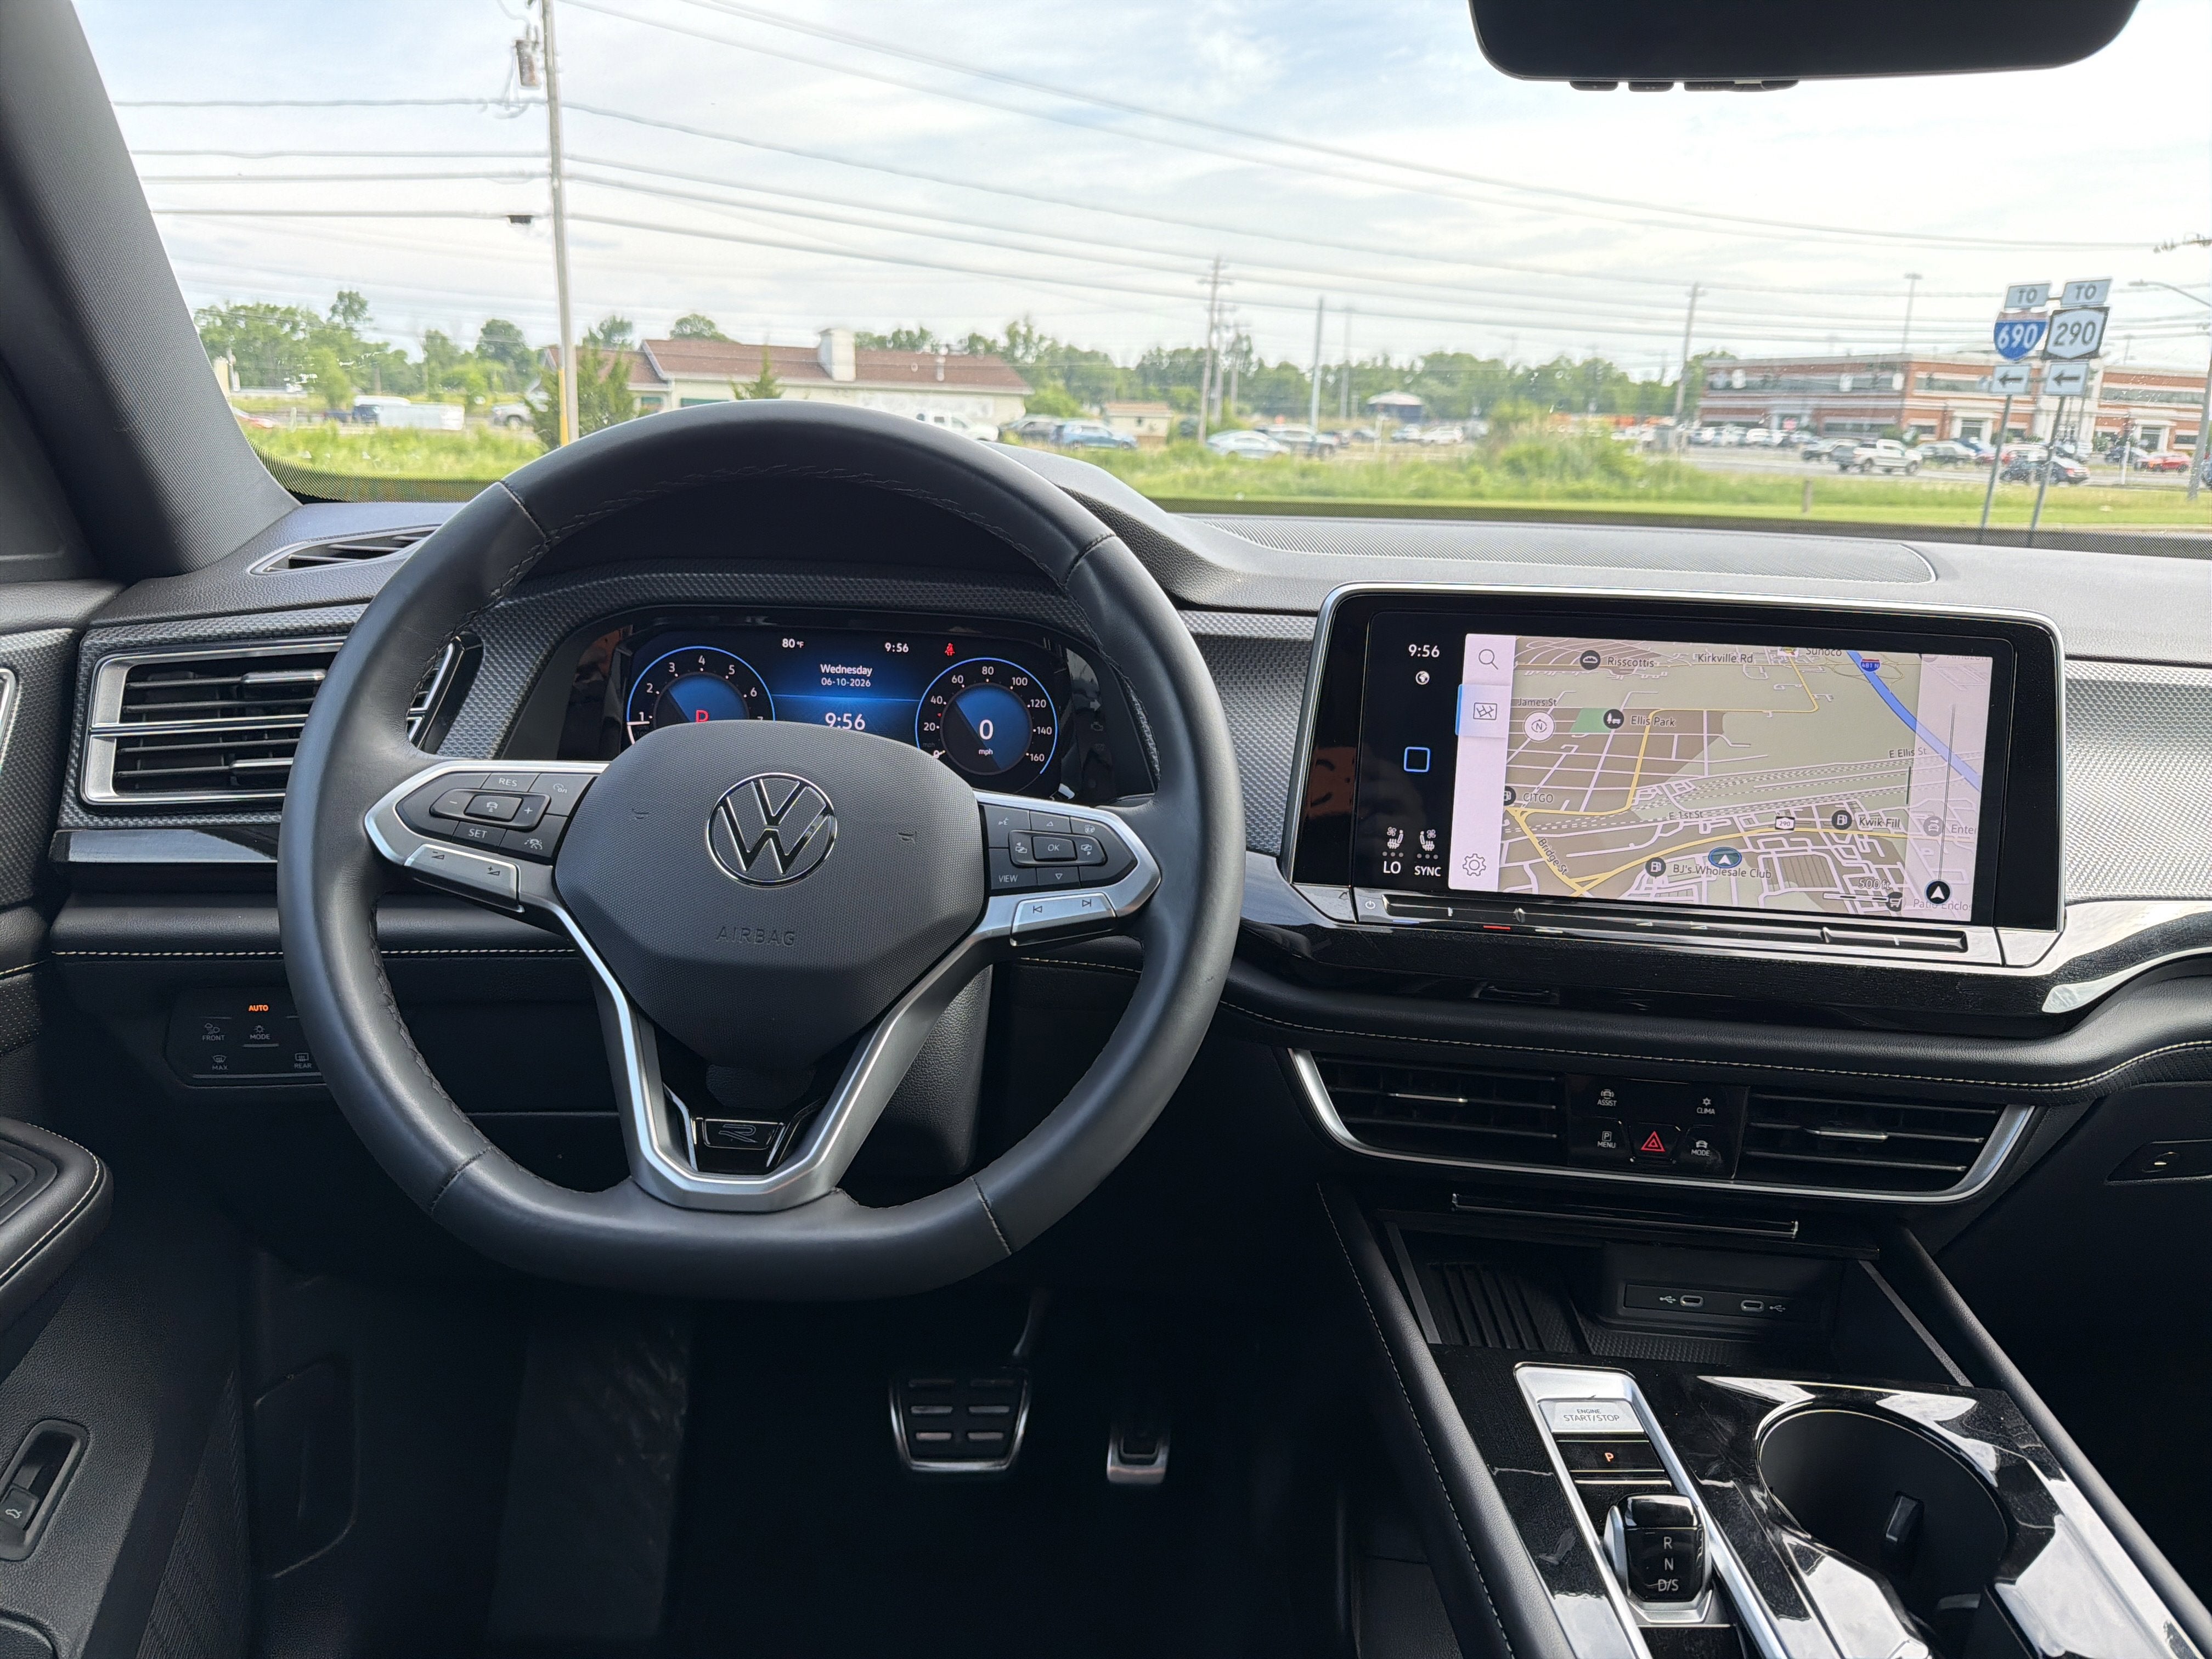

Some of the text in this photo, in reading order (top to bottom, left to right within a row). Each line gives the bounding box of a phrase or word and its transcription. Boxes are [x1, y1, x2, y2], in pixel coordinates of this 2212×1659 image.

[2017, 288, 2038, 304] TO
[2075, 285, 2097, 300] TO
[1997, 324, 2038, 349] 690
[2052, 321, 2096, 347] 290
[884, 642, 909, 653] 9:56
[1408, 644, 1440, 658] 9:56
[698, 655, 706, 665] 4
[1607, 657, 1655, 668] Risscottis
[1698, 653, 1753, 663] Kirkville Rd
[668, 662, 675, 673] 3
[728, 664, 735, 675] 5
[820, 664, 873, 676] Wednesday
[981, 666, 994, 675] 80
[821, 677, 871, 687] 06-10-2026
[951, 675, 964, 684] 60
[1012, 677, 1028, 686] 100
[646, 683, 653, 693] 2
[750, 687, 758, 697] 6
[930, 696, 943, 704] 40
[1030, 699, 1047, 708] 120
[1517, 698, 1557, 707] James St
[639, 712, 645, 721] 1
[825, 713, 866, 730] 9:56
[1631, 715, 1675, 727] Ellis Park
[923, 723, 935, 731] 20
[979, 719, 994, 740] 0
[1037, 726, 1052, 736] 140
[978, 747, 994, 757] mph
[1029, 752, 1045, 761] 160
[1889, 747, 1927, 759] E Ellis St
[499, 777, 518, 787] RES
[1522, 793, 1554, 803] CITGO
[1859, 817, 1900, 828] Kwik Fill
[469, 828, 488, 839] SET
[1538, 838, 1567, 876] Bridge St
[1383, 861, 1402, 874] LO
[1414, 865, 1441, 877] SYNC
[1673, 864, 1771, 879] BJ's Wholesale Club
[998, 874, 1018, 883] VIEW
[715, 926, 795, 947] AIRBAG
[1597, 1099, 1617, 1107] ASSIST
[1696, 1107, 1715, 1115] CLIMA
[1563, 1414, 1620, 1423] START/STOP
[1604, 1452, 1615, 1462] P
[1663, 1536, 1673, 1549] R
[1664, 1558, 1674, 1571] N
[1657, 1578, 1679, 1592] D/S
